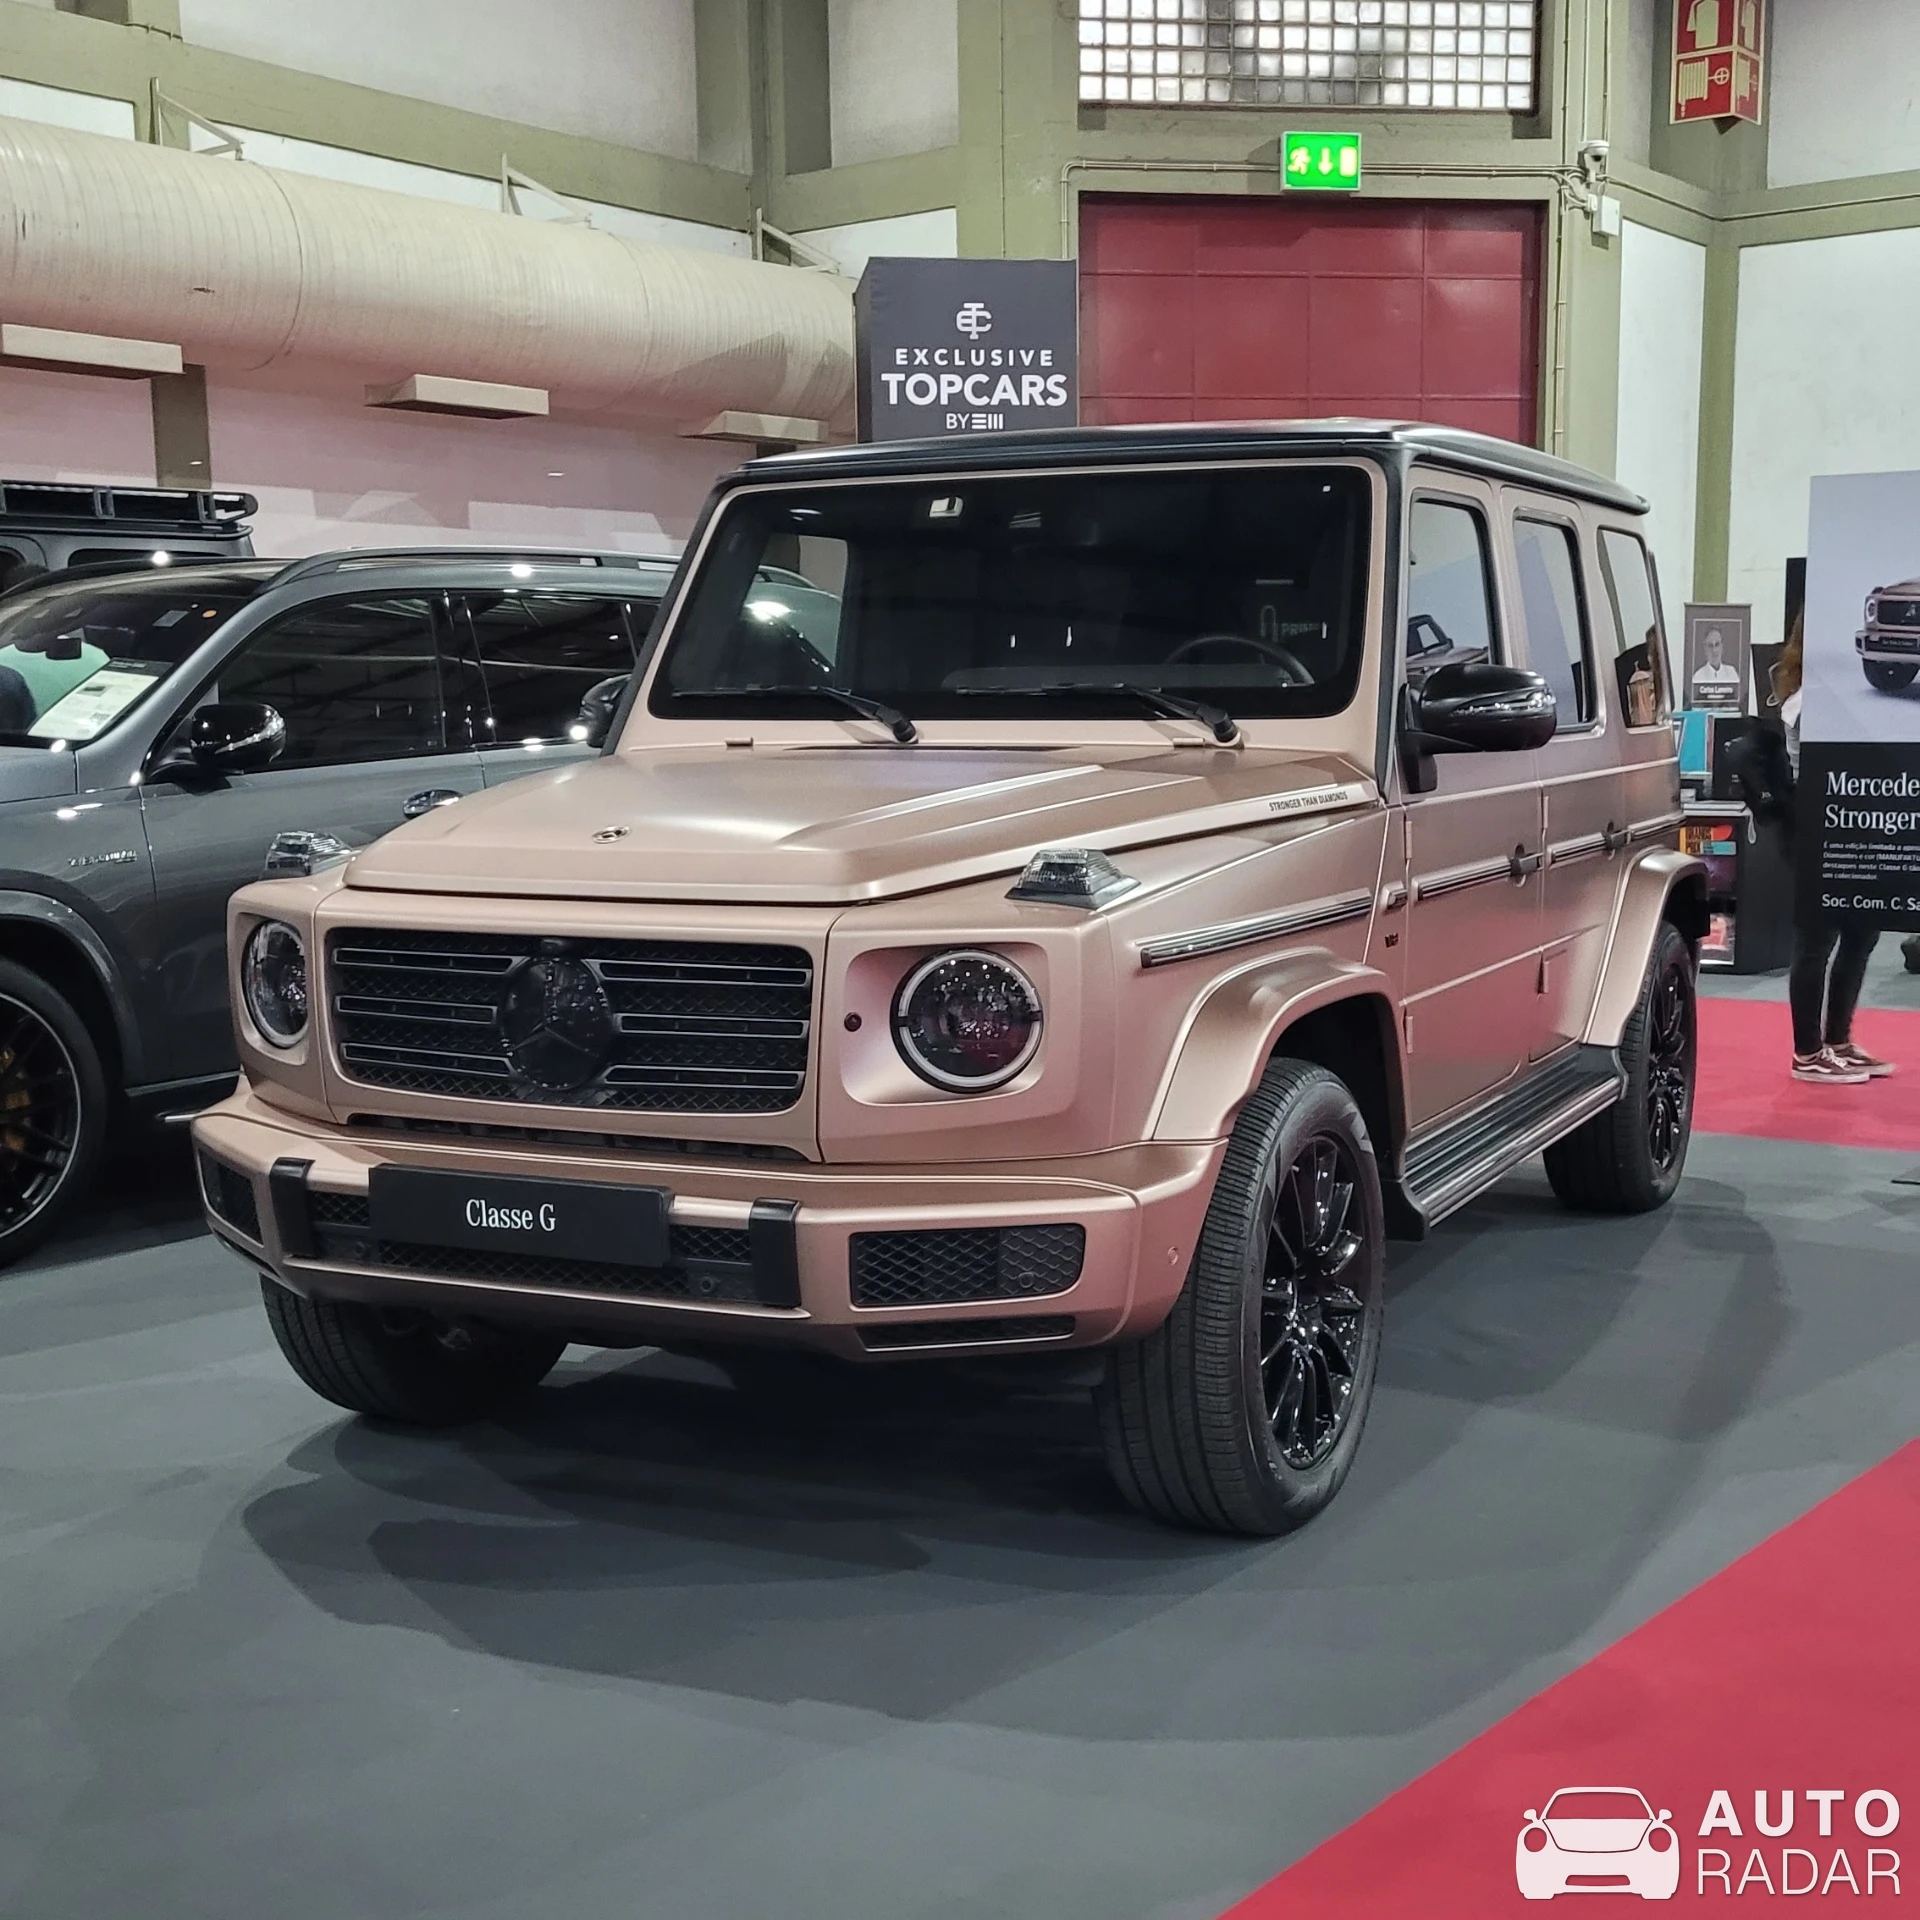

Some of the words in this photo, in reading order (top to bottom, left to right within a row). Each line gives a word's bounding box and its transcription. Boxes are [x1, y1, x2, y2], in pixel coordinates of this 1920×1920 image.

[895, 348, 1053, 367] EXCLUSIVE
[881, 373, 1067, 406] TOPCARS
[1826, 771, 1920, 797] Mercede
[1269, 798, 1301, 811] STRONGER
[1301, 794, 1319, 807] THAN
[1319, 791, 1348, 804] DIAMONDS
[1824, 804, 1920, 836] Stronger
[1822, 894, 1850, 908] Soc.
[1852, 894, 1888, 910] Com.
[1890, 896, 1904, 910] C.
[465, 1198, 533, 1231] Classe
[539, 1203, 556, 1232] G
